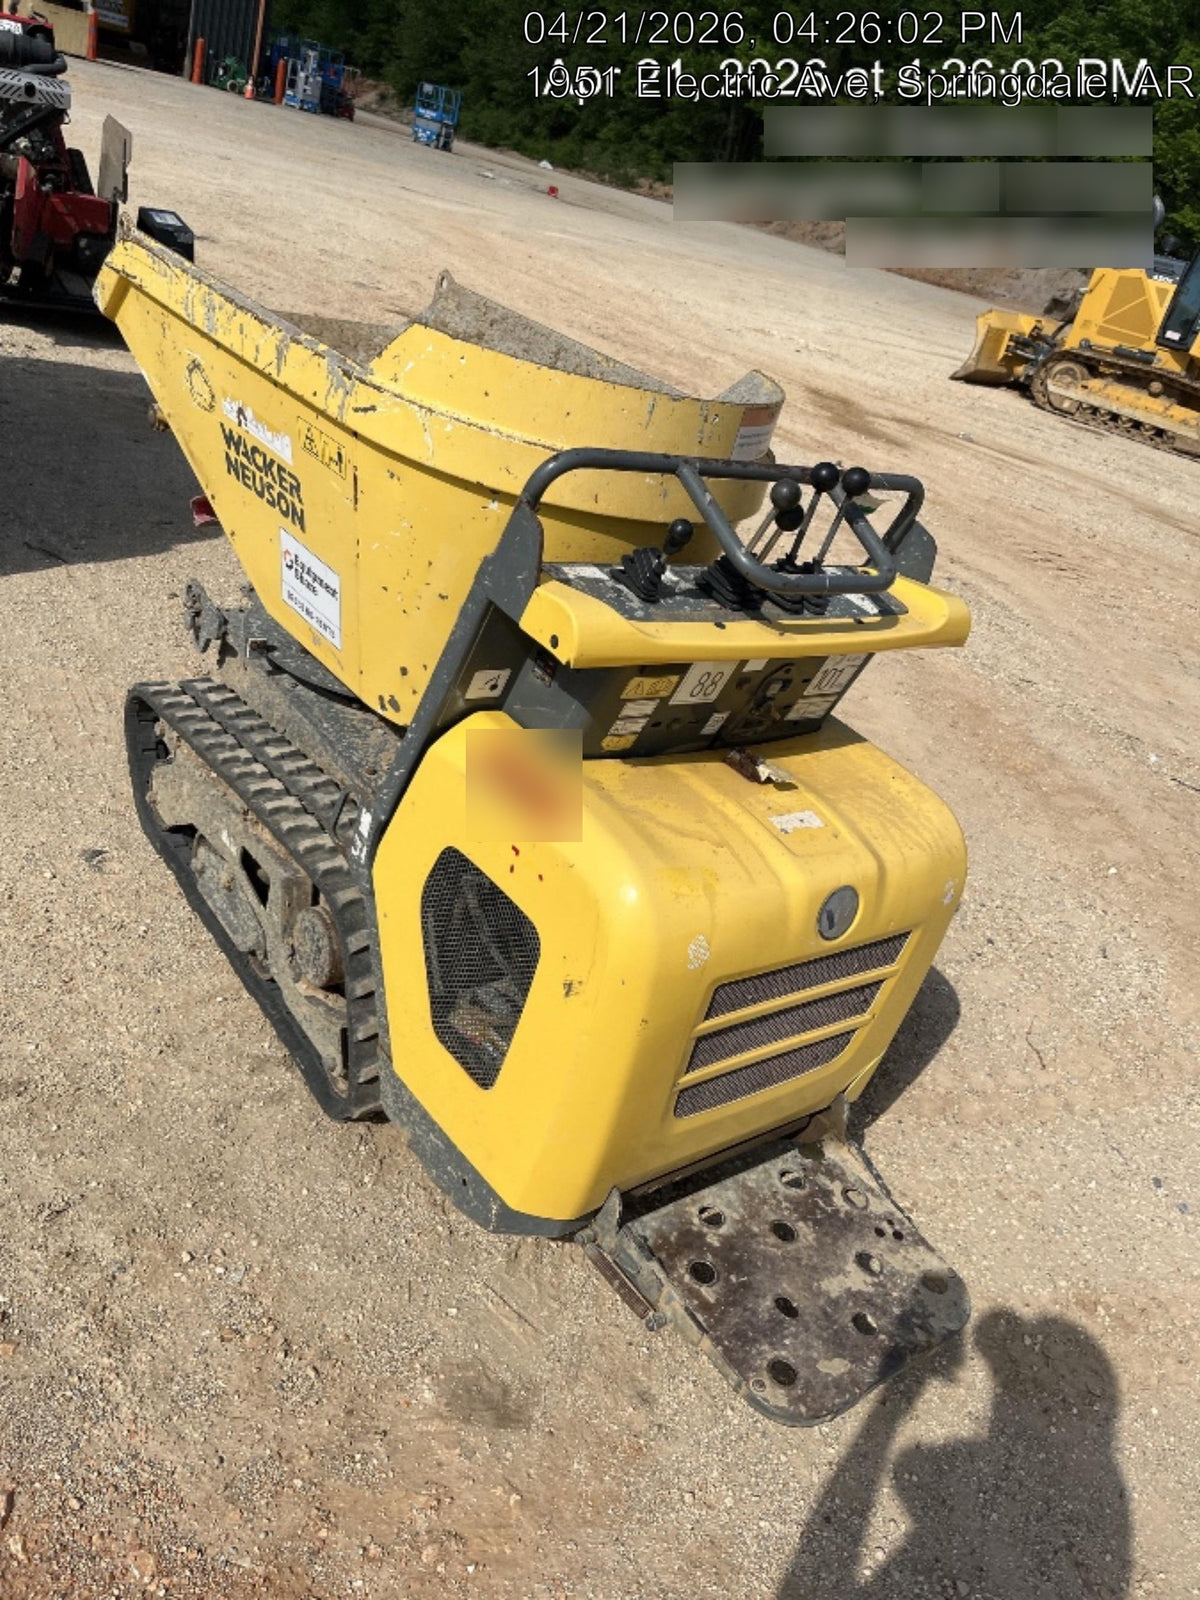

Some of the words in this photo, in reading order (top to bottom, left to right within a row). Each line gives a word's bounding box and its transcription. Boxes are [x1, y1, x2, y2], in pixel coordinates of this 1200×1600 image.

[219, 420, 304, 506] WACKER
[225, 450, 306, 534] NEUSON
[689, 671, 725, 698] 88
